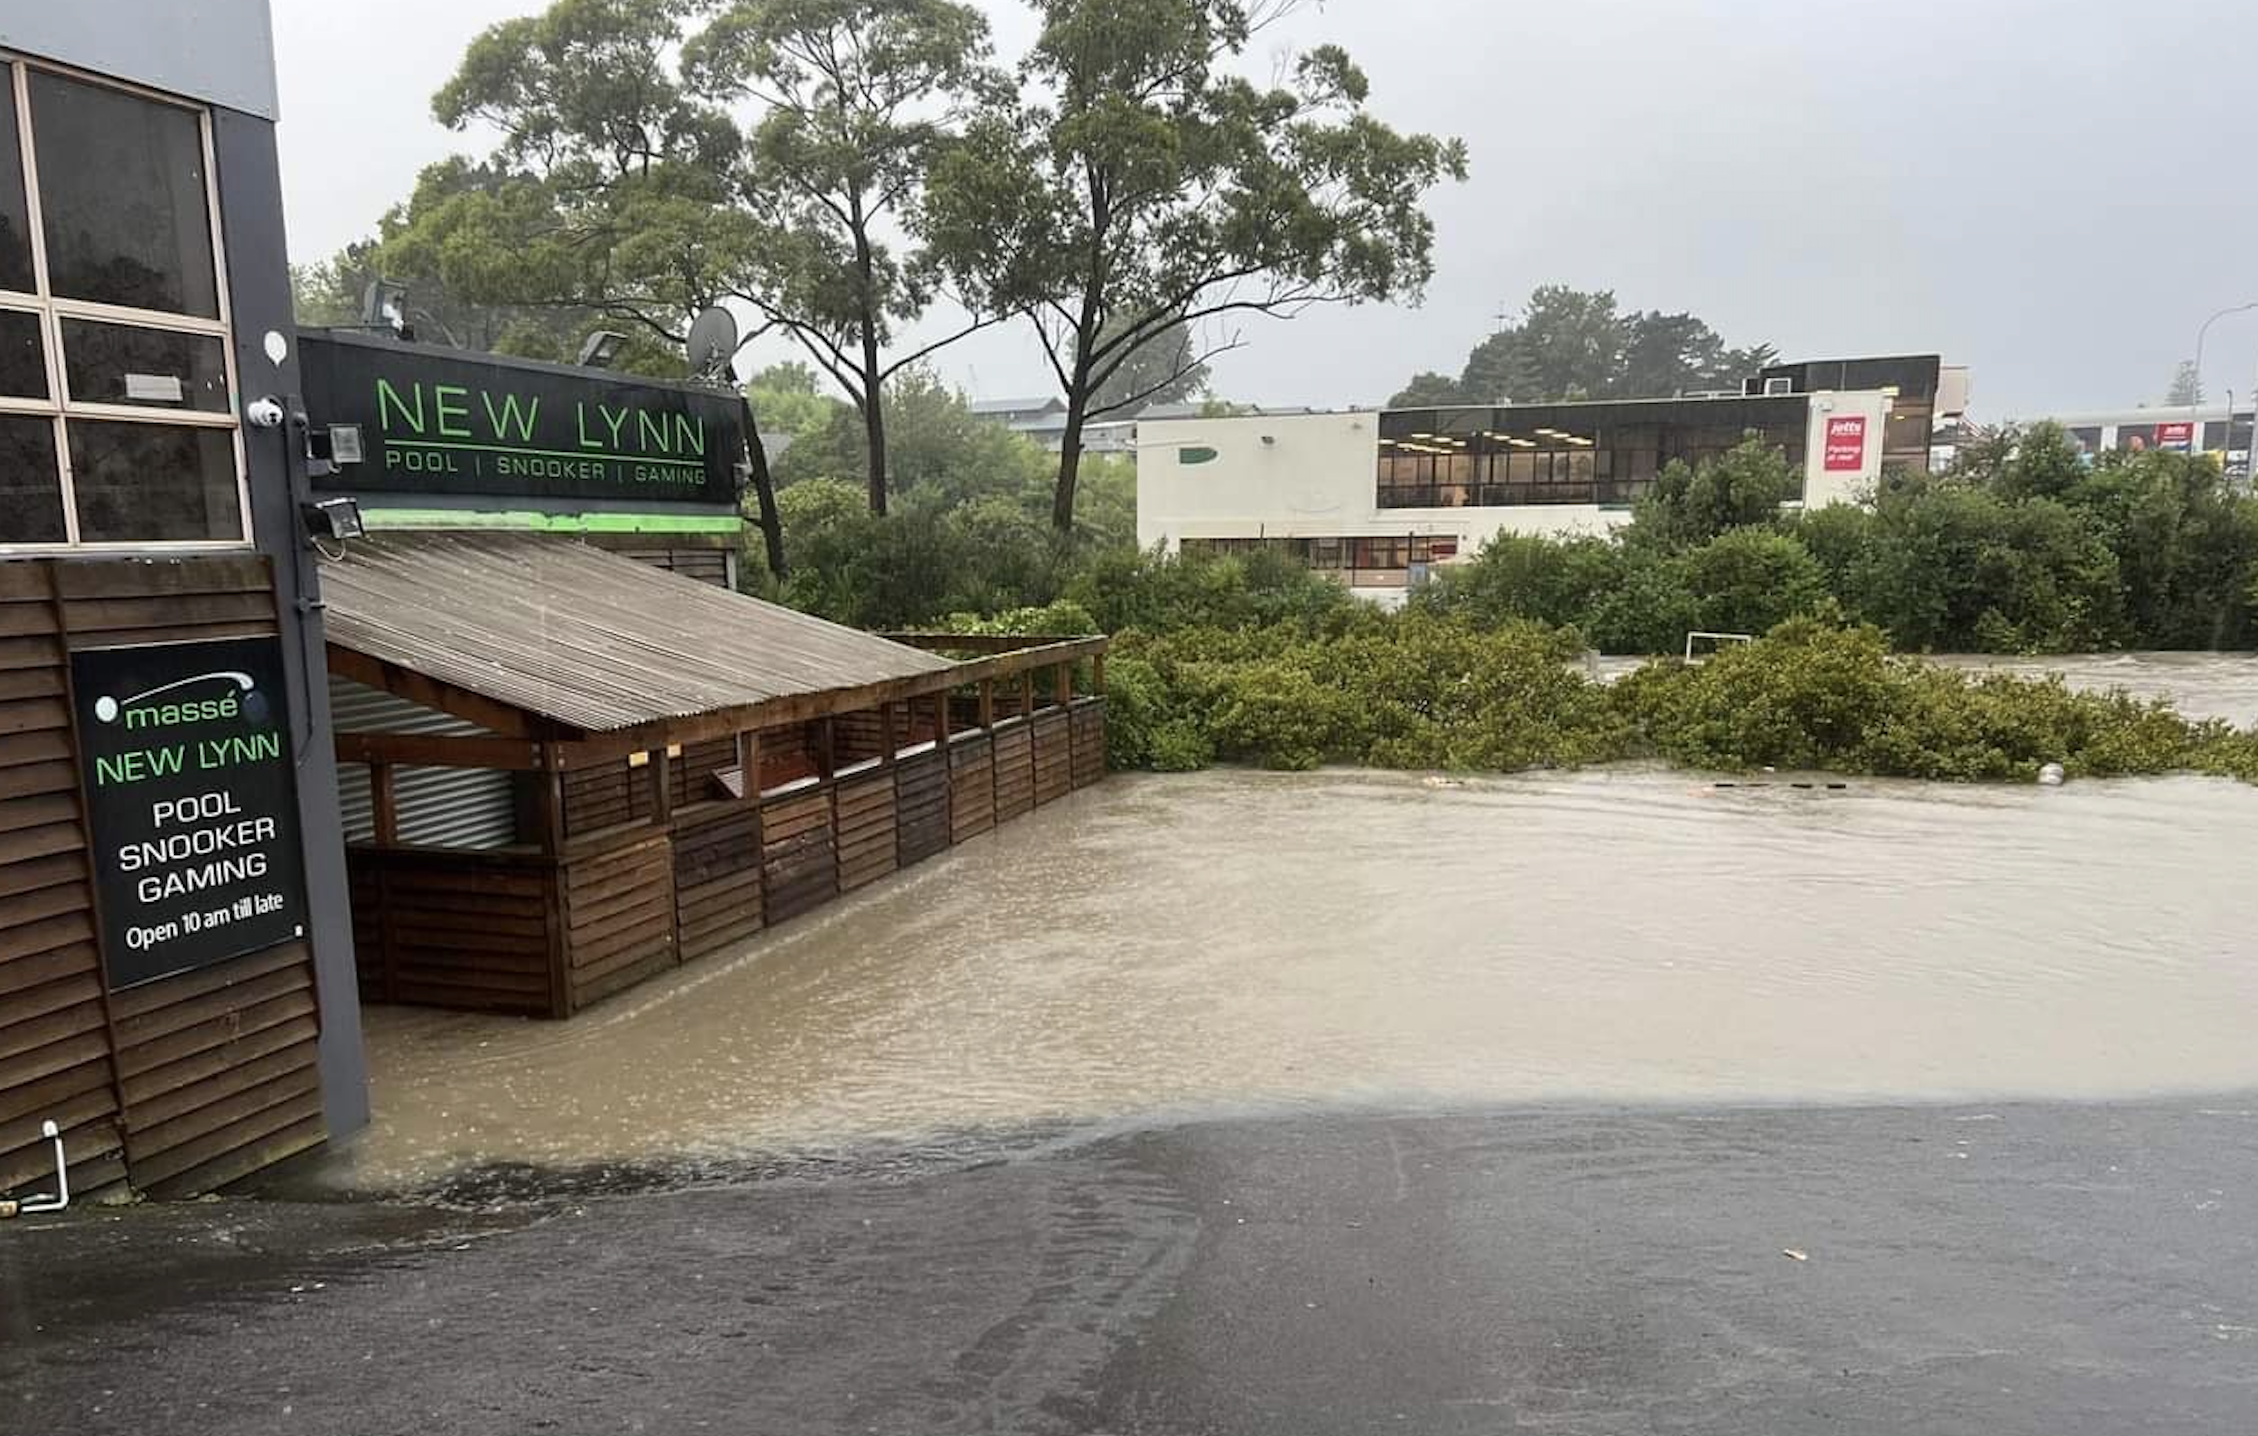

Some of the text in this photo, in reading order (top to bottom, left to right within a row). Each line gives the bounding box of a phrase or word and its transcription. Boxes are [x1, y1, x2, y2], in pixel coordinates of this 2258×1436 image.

[376, 378, 705, 456] NEW LYNN
[386, 451, 705, 485] POOL SNOOKER GAMING
[126, 690, 239, 730] massé
[96, 732, 280, 785] NEW LYNN
[153, 791, 241, 828] POOL
[119, 817, 276, 871] SNOOKER
[138, 853, 267, 903] GAMING
[126, 892, 284, 951] Open 10 am till late
